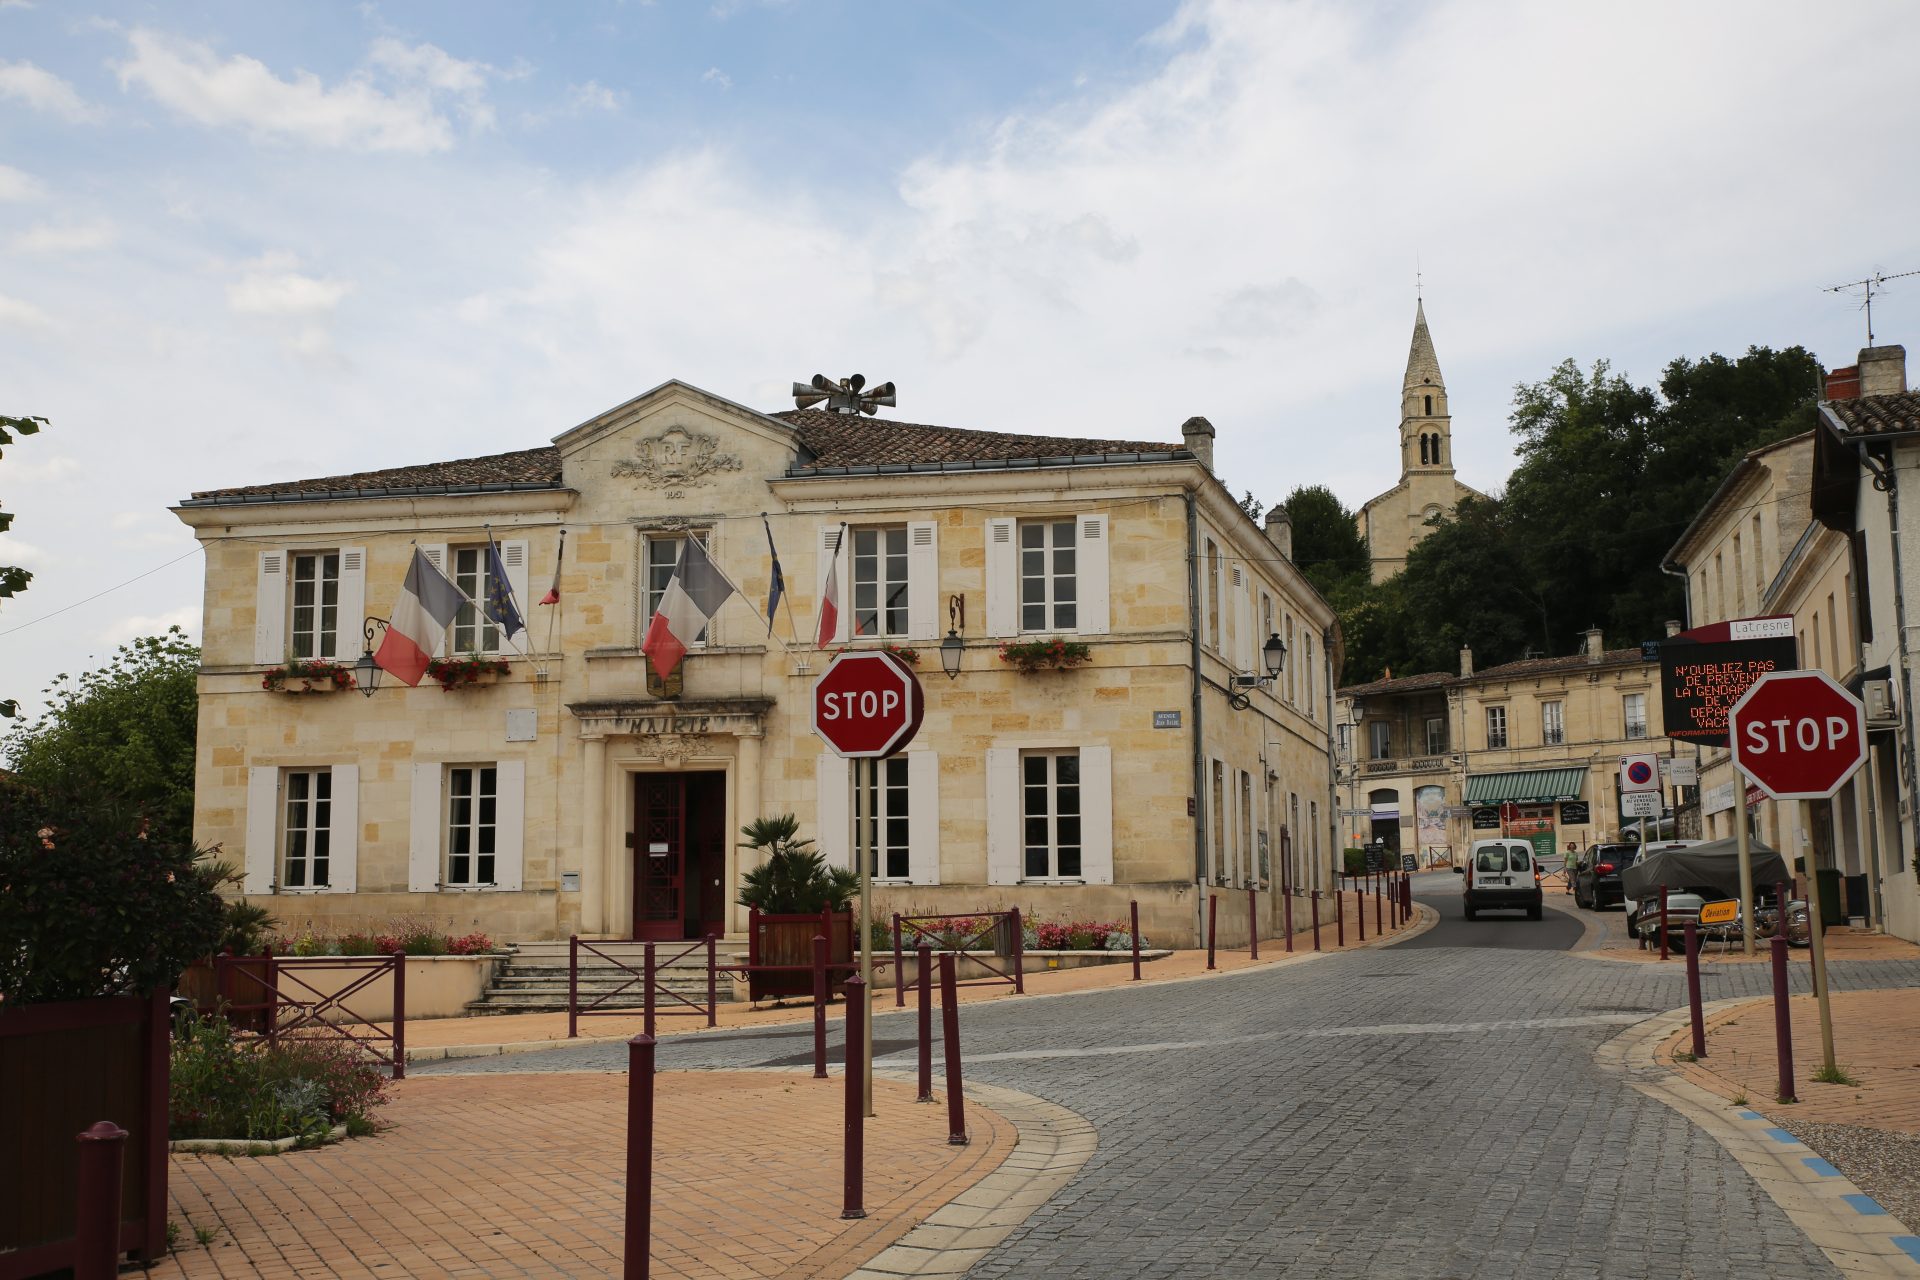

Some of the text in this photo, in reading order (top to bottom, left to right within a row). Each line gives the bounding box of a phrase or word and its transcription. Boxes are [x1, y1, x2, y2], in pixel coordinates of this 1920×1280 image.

[1675, 660, 1775, 677] N'OUBLIEZ PAS
[1685, 675, 1703, 687] DE
[1675, 687, 1691, 698] LA
[823, 689, 899, 720] STOP
[1705, 696, 1721, 707] DE
[1690, 706, 1731, 718] DEPAR
[630, 716, 709, 733] MAIRIE
[1696, 717, 1729, 728] VACA
[1746, 716, 1849, 754] STOP
